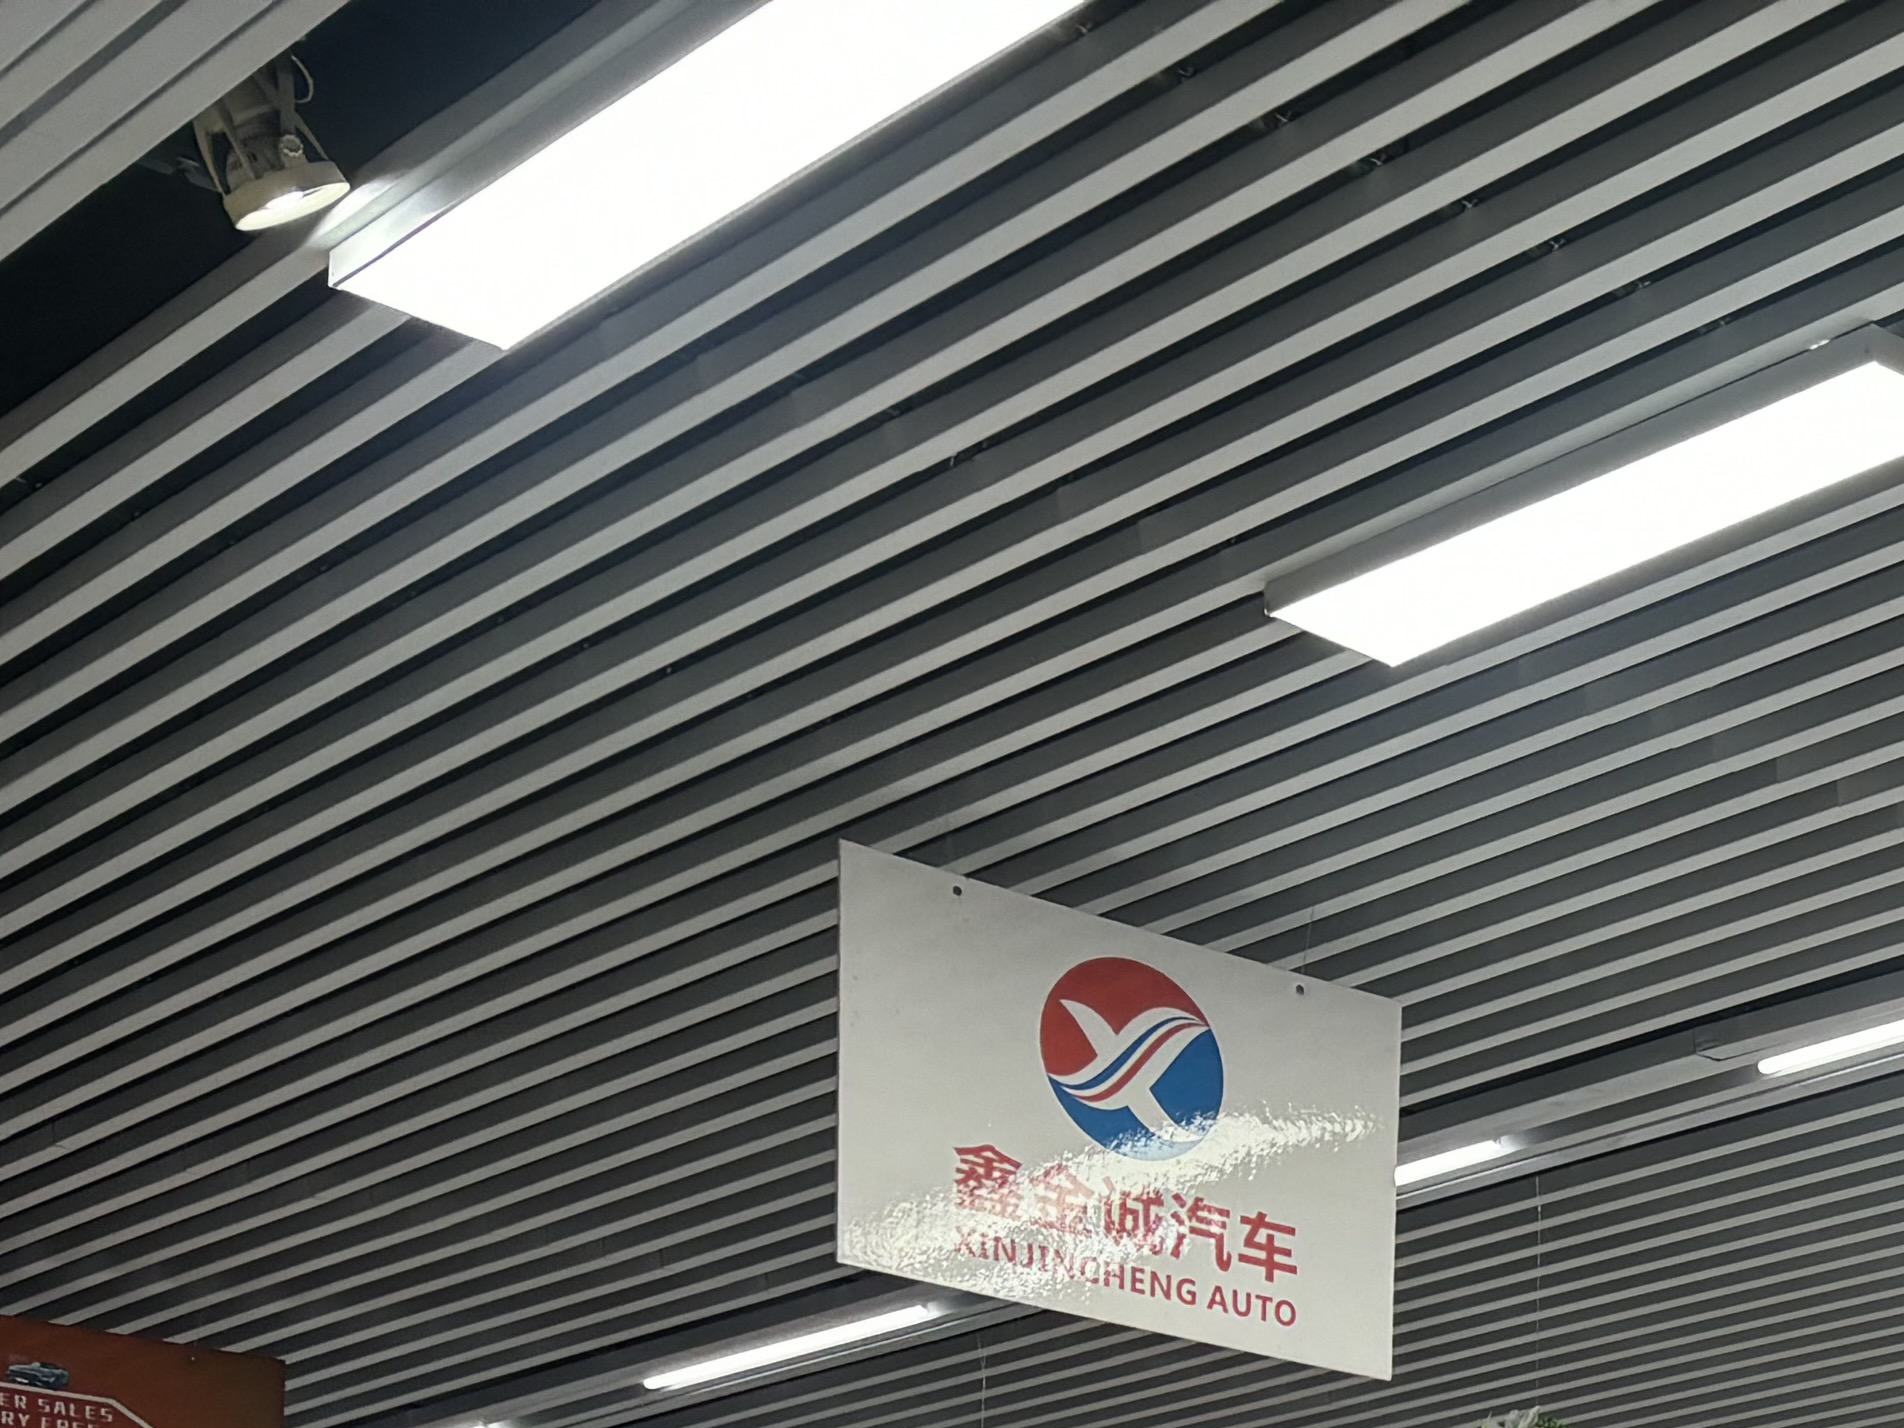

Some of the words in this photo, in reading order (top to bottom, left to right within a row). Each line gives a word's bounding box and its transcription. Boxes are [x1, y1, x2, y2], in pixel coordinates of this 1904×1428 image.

[953, 1144, 1298, 1283] 鑫金诚汽车
[1206, 1285, 1298, 1327] AUTO
[38, 1398, 113, 1422] SALES
